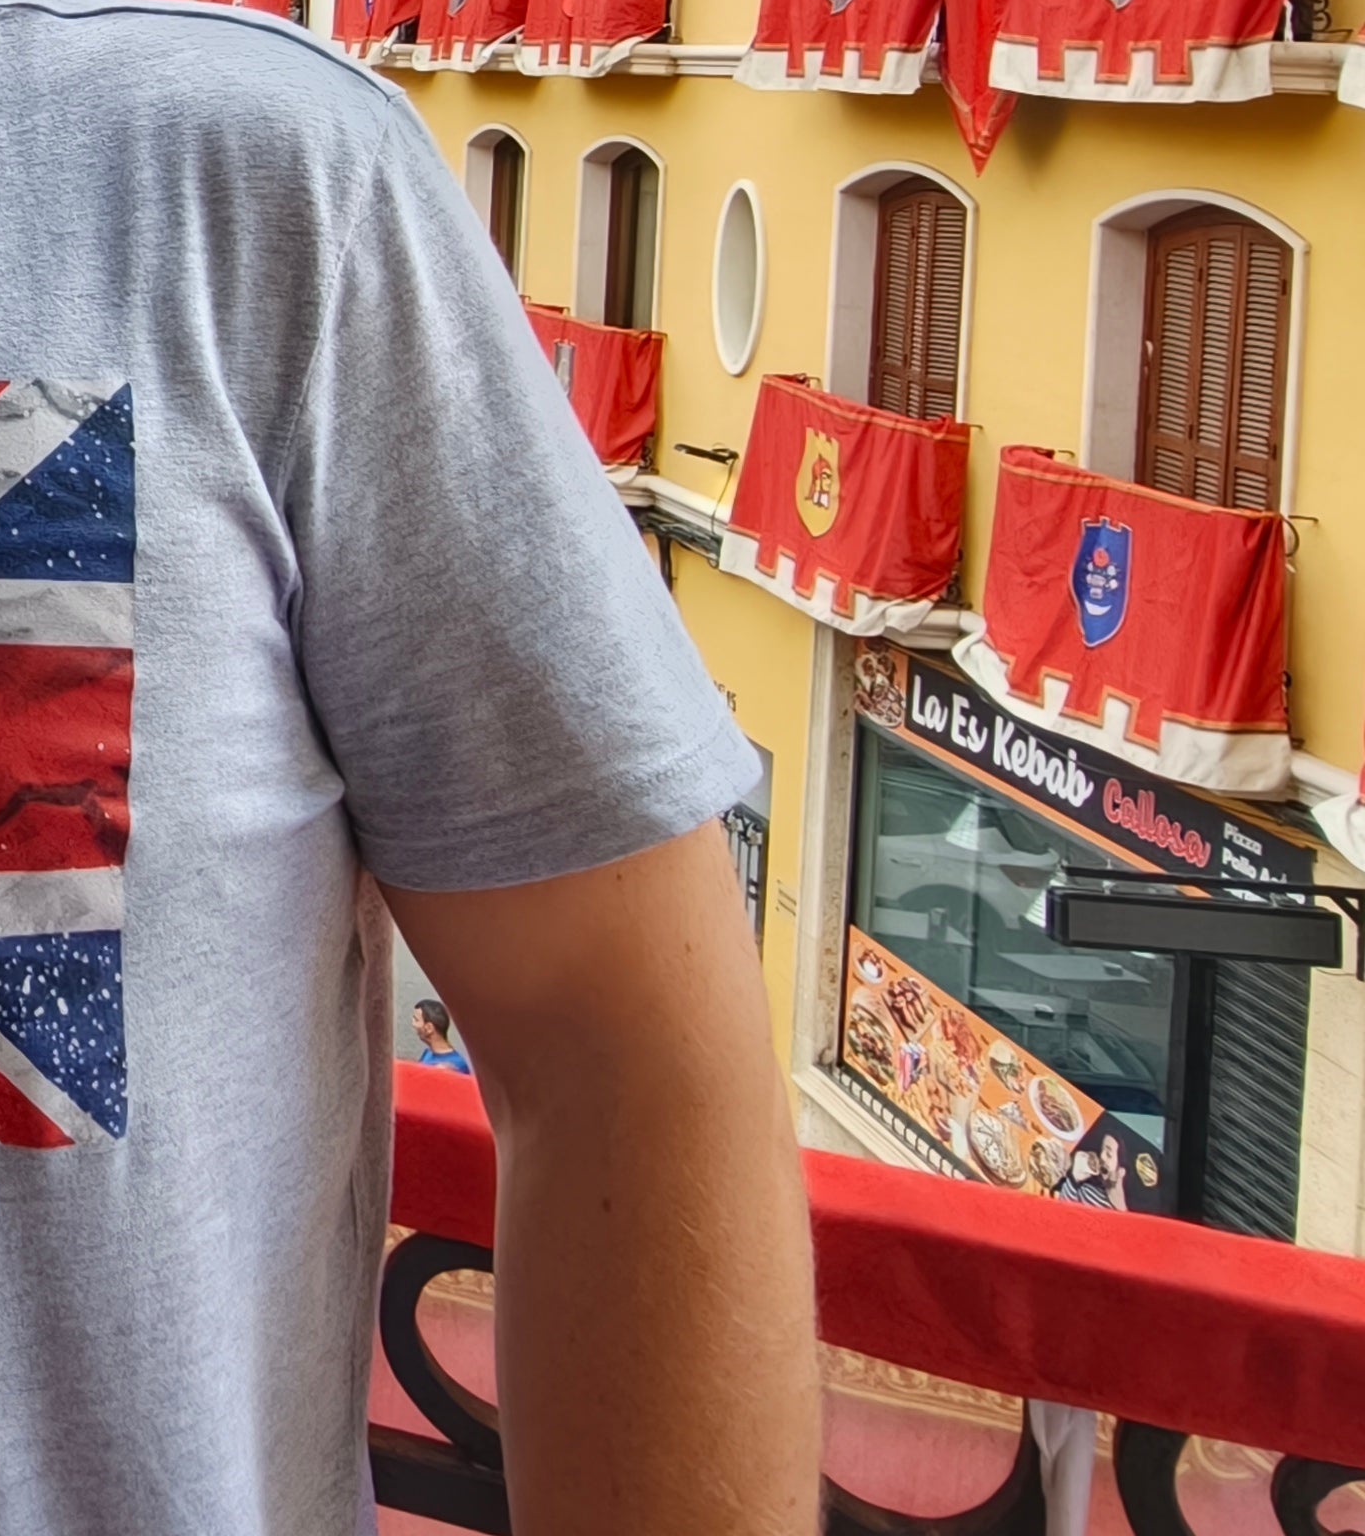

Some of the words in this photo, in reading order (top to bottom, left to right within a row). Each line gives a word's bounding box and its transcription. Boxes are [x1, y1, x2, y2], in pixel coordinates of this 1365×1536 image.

[912, 674, 948, 734] La
[992, 715, 1095, 808] Kebab
[1102, 777, 1212, 869] Callosa
